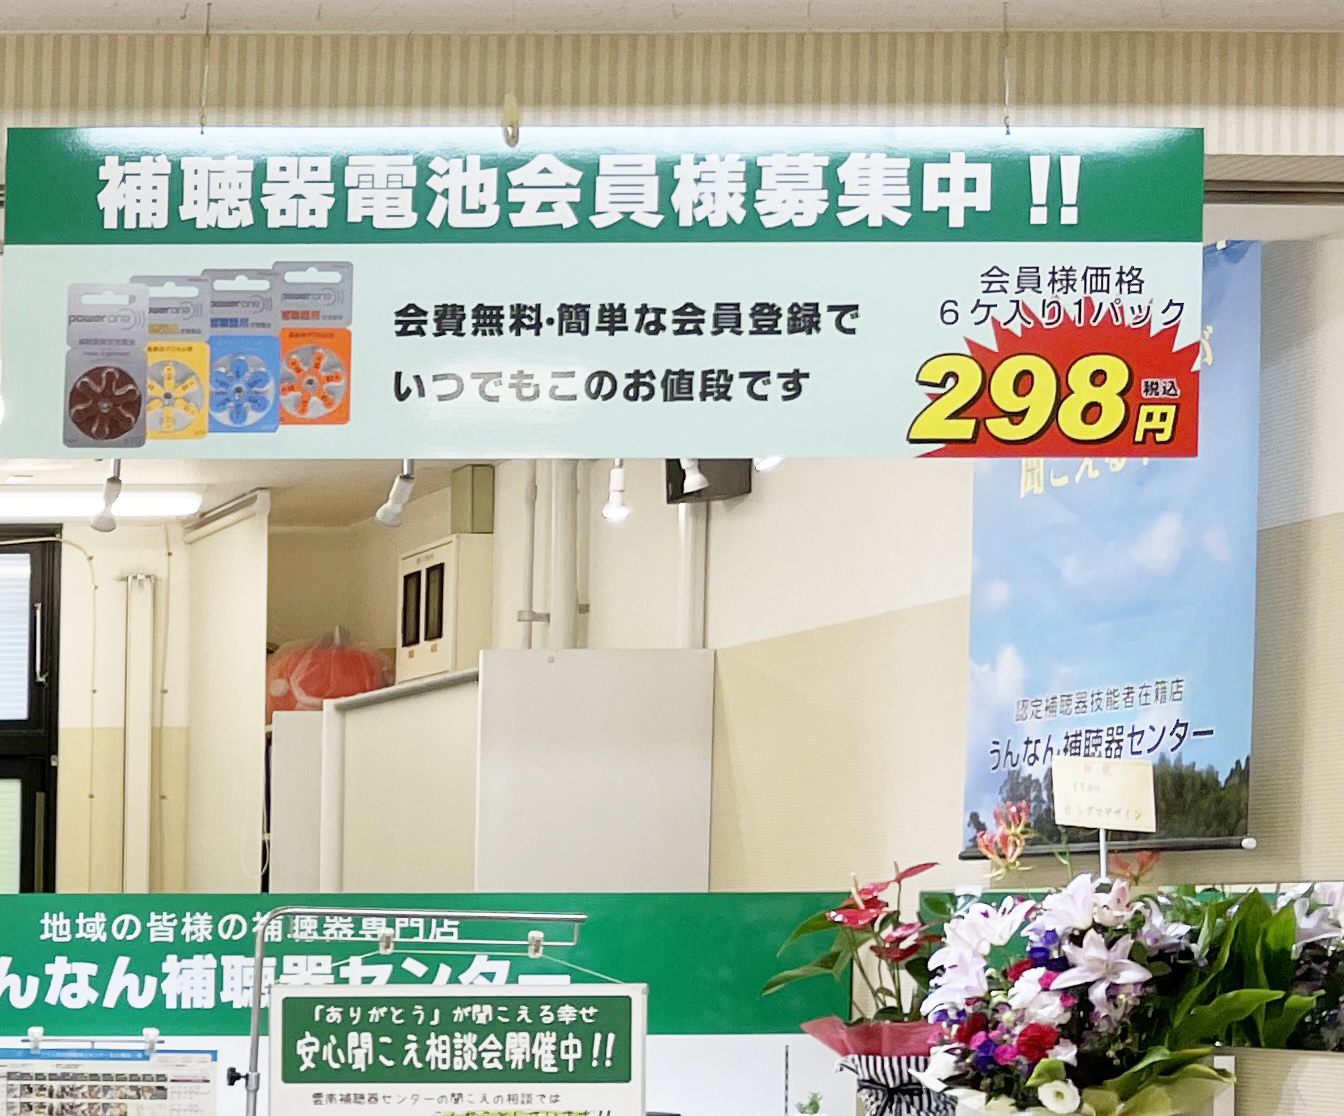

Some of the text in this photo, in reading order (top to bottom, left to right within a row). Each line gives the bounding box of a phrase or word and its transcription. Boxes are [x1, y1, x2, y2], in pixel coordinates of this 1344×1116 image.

[979, 265, 1145, 296] 会員様価格
[393, 302, 862, 340] 会費無料・簡単な会員登録で
[393, 367, 811, 405] いつでもこのお値段です
[1142, 379, 1179, 398] 税込
[989, 717, 1214, 771] うんなん補聴器センター
[313, 1003, 599, 1026] 「ありがとう」が聞こえる幸せ
[295, 1030, 616, 1074] 安心聞こえ相談会開催中!!
